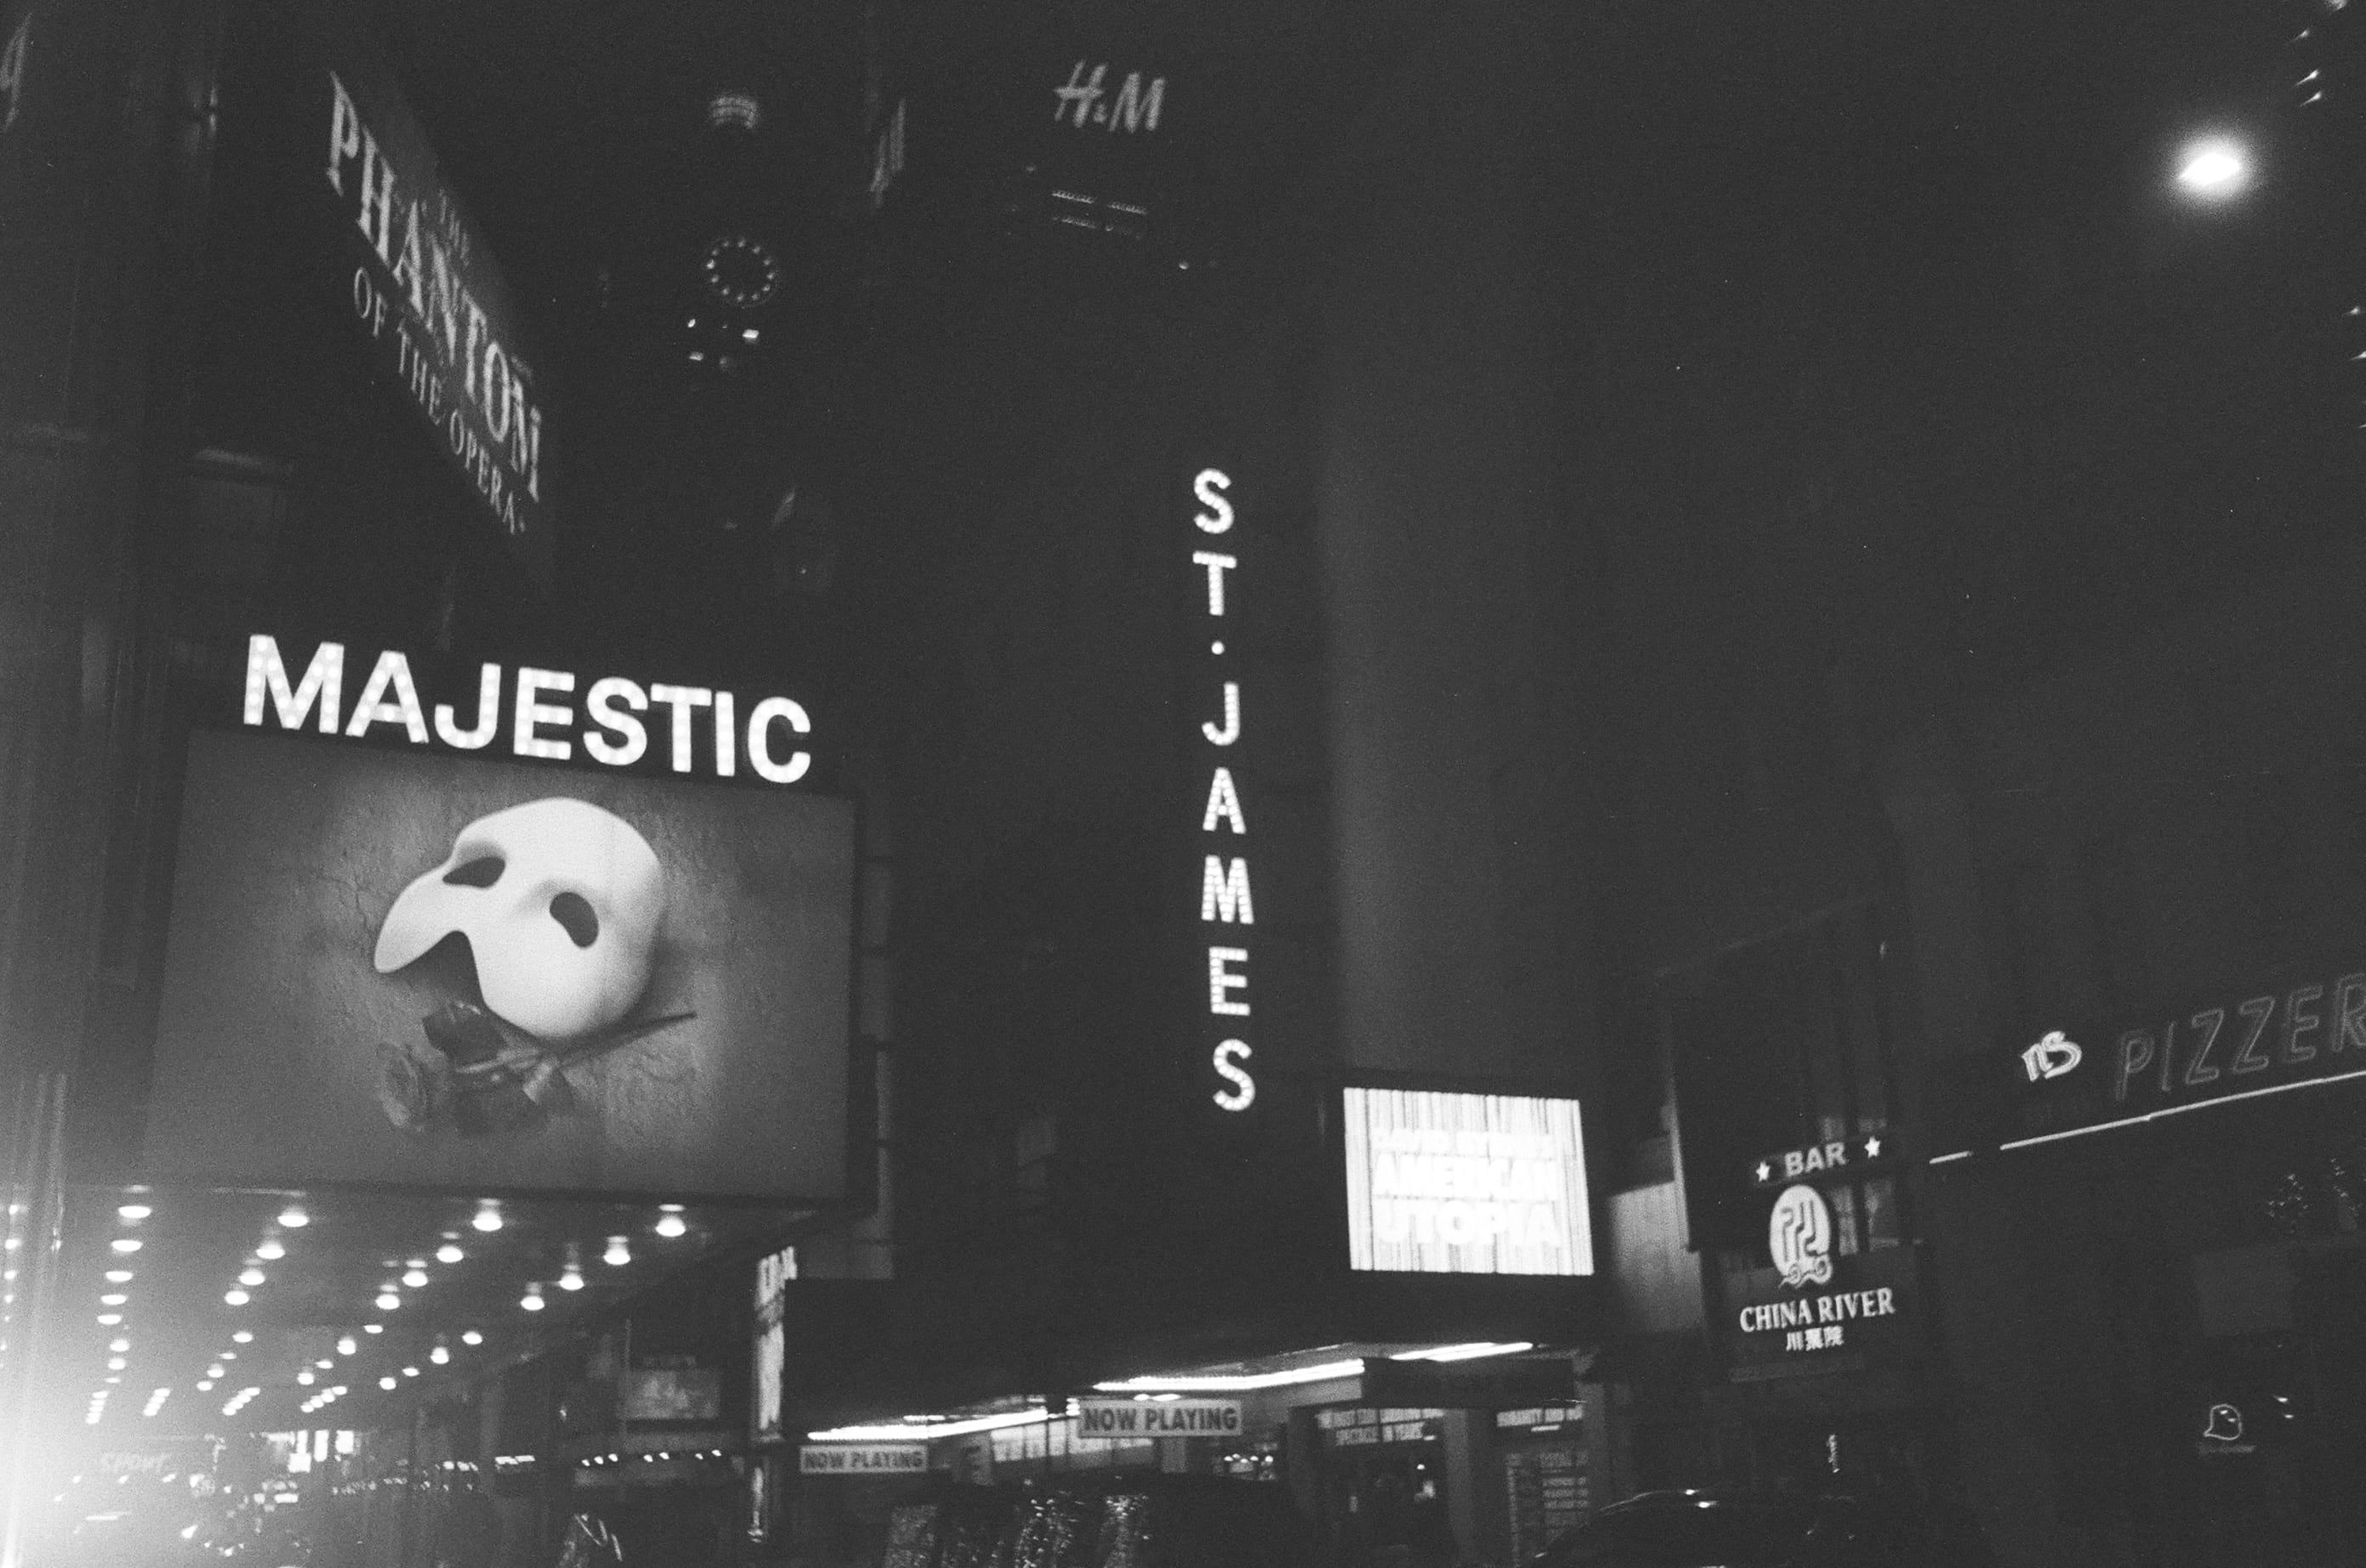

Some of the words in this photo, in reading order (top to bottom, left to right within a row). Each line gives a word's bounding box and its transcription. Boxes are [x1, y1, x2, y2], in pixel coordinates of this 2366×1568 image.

[1053, 59, 1166, 133] H&M
[326, 71, 541, 502] PHANTOM
[353, 266, 387, 339] OF
[397, 318, 445, 426] THE
[449, 408, 516, 535] OPERA
[243, 633, 812, 785] MAJESTIC
[1200, 680, 1256, 1113] JAMES
[1374, 1153, 1559, 1201] AMERICAN
[1784, 1142, 1848, 1177] BAR
[1375, 1199, 1561, 1248] UTOPIA
[1739, 1298, 1812, 1333] CHINA
[1816, 1287, 1896, 1323] RIVER
[1083, 1407, 1137, 1431] NOW
[1144, 1406, 1239, 1432] PLAYING
[804, 1449, 844, 1469] NOW
[850, 1447, 923, 1469] PLAYING
